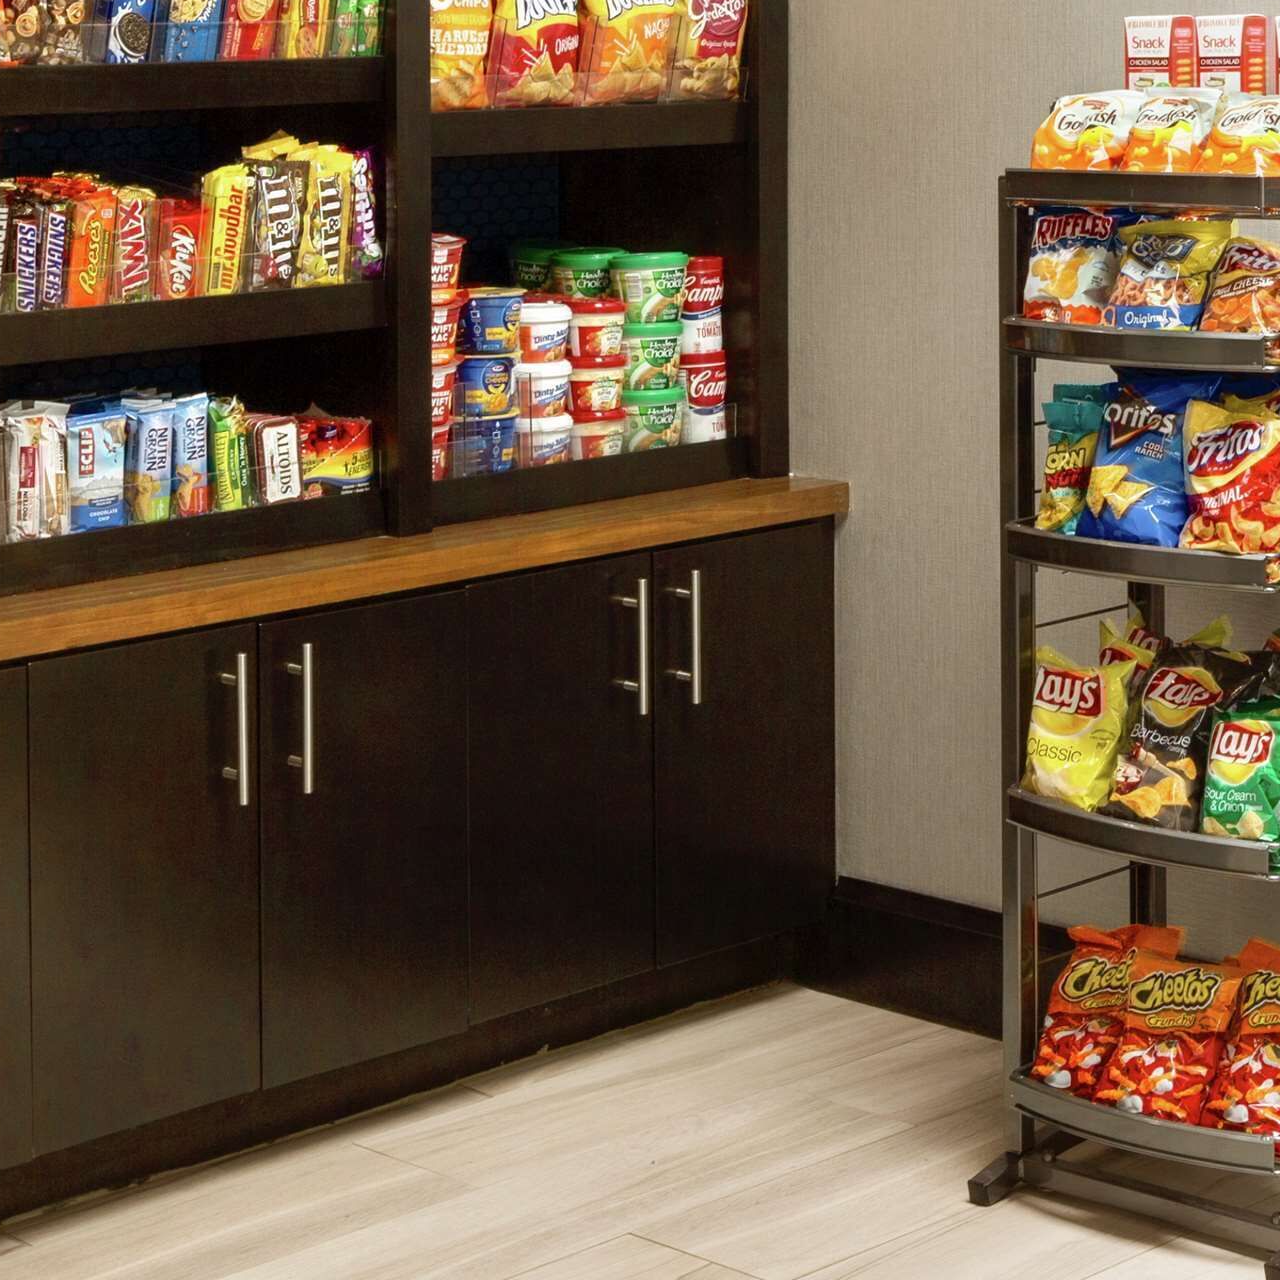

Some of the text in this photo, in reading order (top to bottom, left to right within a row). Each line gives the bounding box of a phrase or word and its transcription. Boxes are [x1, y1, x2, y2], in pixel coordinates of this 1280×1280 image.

[1131, 35, 1165, 49] Snack
[1202, 34, 1236, 49] Snack
[1129, 58, 1168, 67] CHICKEN SALAD
[1200, 58, 1240, 66] CHICKEN SALAD
[1031, 216, 1113, 246] RUFFLES
[43, 212, 66, 303] SNICKERS
[79, 221, 102, 295] Reese's
[119, 199, 150, 296] TWIX
[16, 222, 37, 312] SNICKERS
[431, 264, 454, 274] WIFT
[431, 324, 452, 334] WIFT
[534, 333, 555, 345] Dinty
[696, 326, 721, 338] TOMAT
[644, 347, 674, 359] Choice
[534, 387, 556, 399] Dinty
[1103, 401, 1177, 434] oritos
[157, 426, 169, 471] NUTRI
[185, 418, 198, 462] GRAIN
[195, 415, 206, 459] NUTRI
[1143, 440, 1164, 453] COOL
[1187, 423, 1266, 472] Fritos
[146, 428, 158, 473] GRAIN
[276, 431, 293, 495] ALTOIDS
[1134, 445, 1164, 460] RANCH
[1033, 666, 1098, 714] Lay's
[1130, 722, 1192, 748] Barbecue
[1210, 722, 1270, 765] Lay's
[1026, 736, 1082, 763] Classic
[1204, 787, 1257, 802] Sour Cream
[1209, 801, 1245, 812] & Onion
[1130, 969, 1219, 1012] Cheetos
[1144, 1014, 1197, 1029] Crunchy
